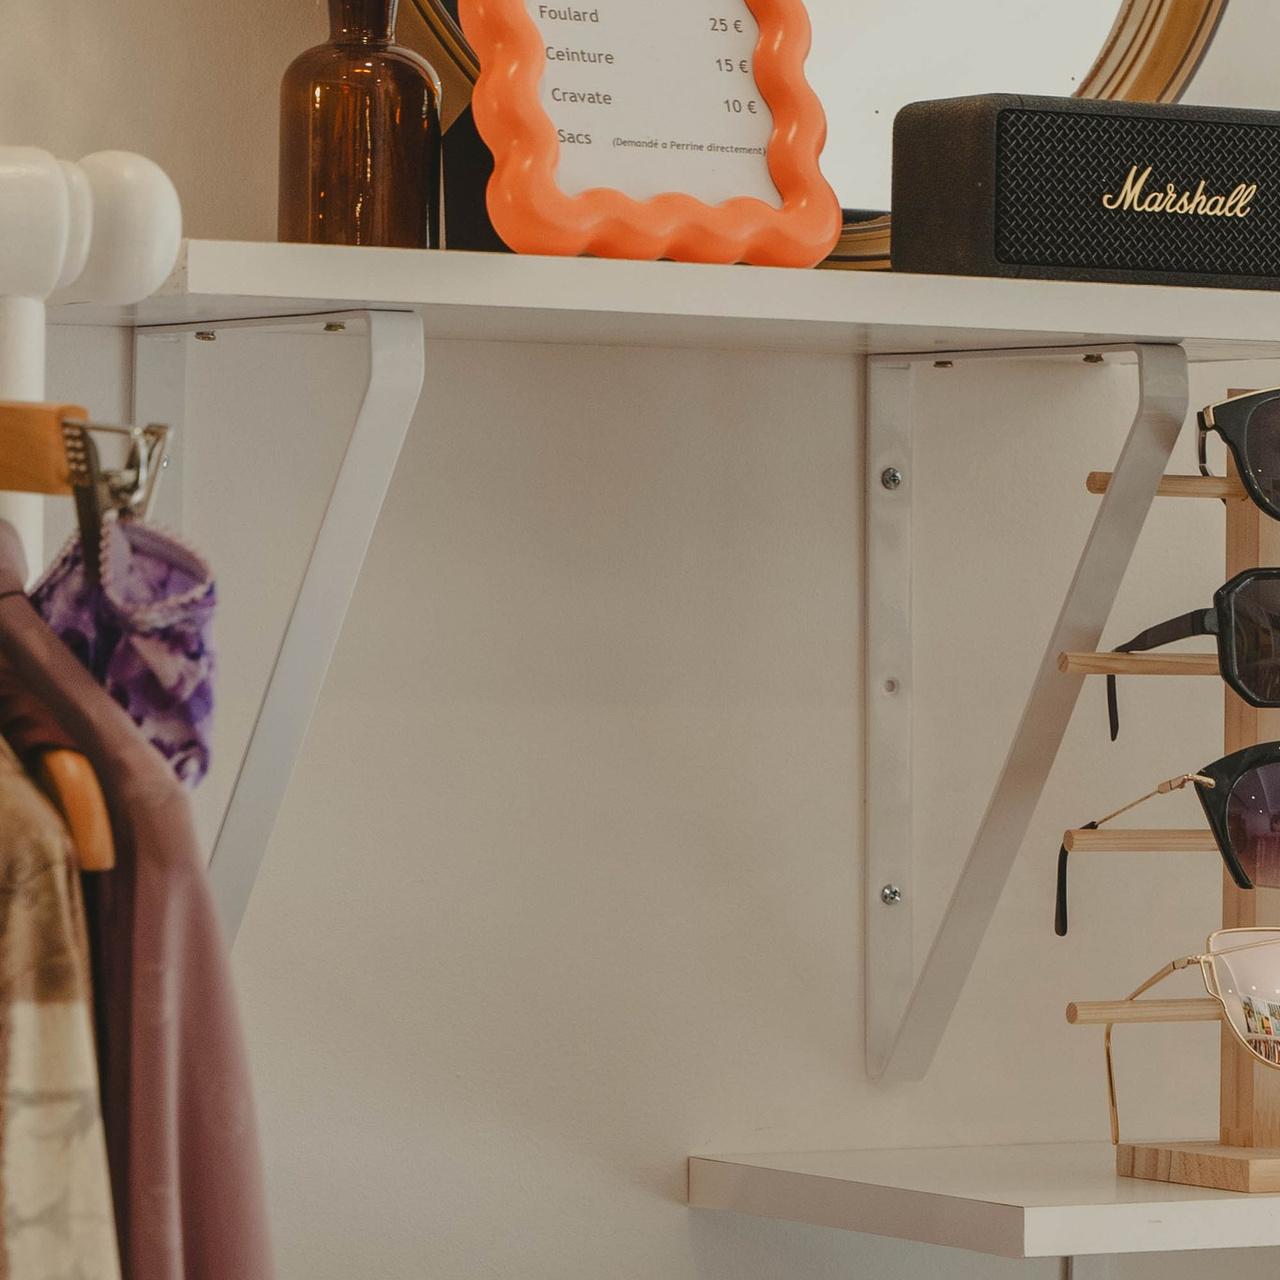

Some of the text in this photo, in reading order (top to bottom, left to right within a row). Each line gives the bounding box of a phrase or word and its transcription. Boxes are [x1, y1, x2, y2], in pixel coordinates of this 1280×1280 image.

[538, 5, 743, 33] Foulard 25 €
[545, 46, 749, 73] Ceinture 15 €
[551, 87, 757, 114] Cravate 10 €
[557, 128, 593, 145] Sacs
[670, 140, 704, 152] Perrine
[1102, 165, 1258, 218] Marshall
